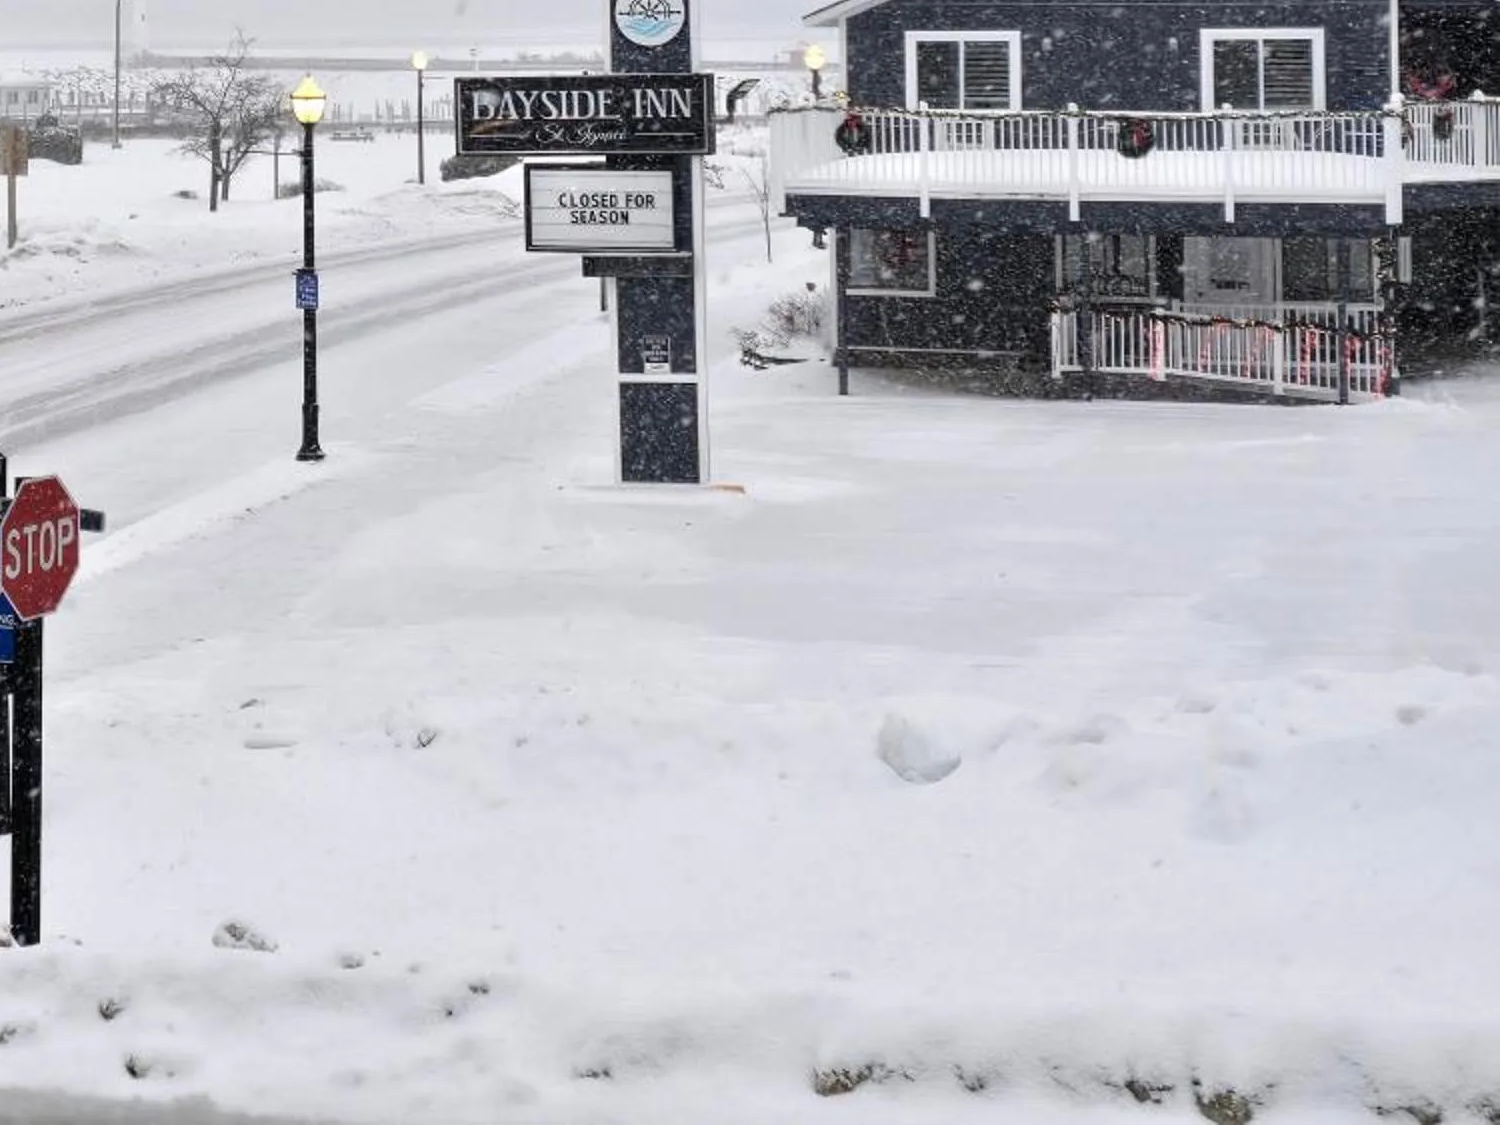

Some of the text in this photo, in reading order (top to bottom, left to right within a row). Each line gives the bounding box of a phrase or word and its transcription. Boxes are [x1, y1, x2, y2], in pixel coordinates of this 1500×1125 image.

[633, 88, 692, 118] INN
[559, 193, 656, 208] CLOSED FOR
[570, 210, 629, 225] SEASON
[5, 516, 76, 579] STOP
